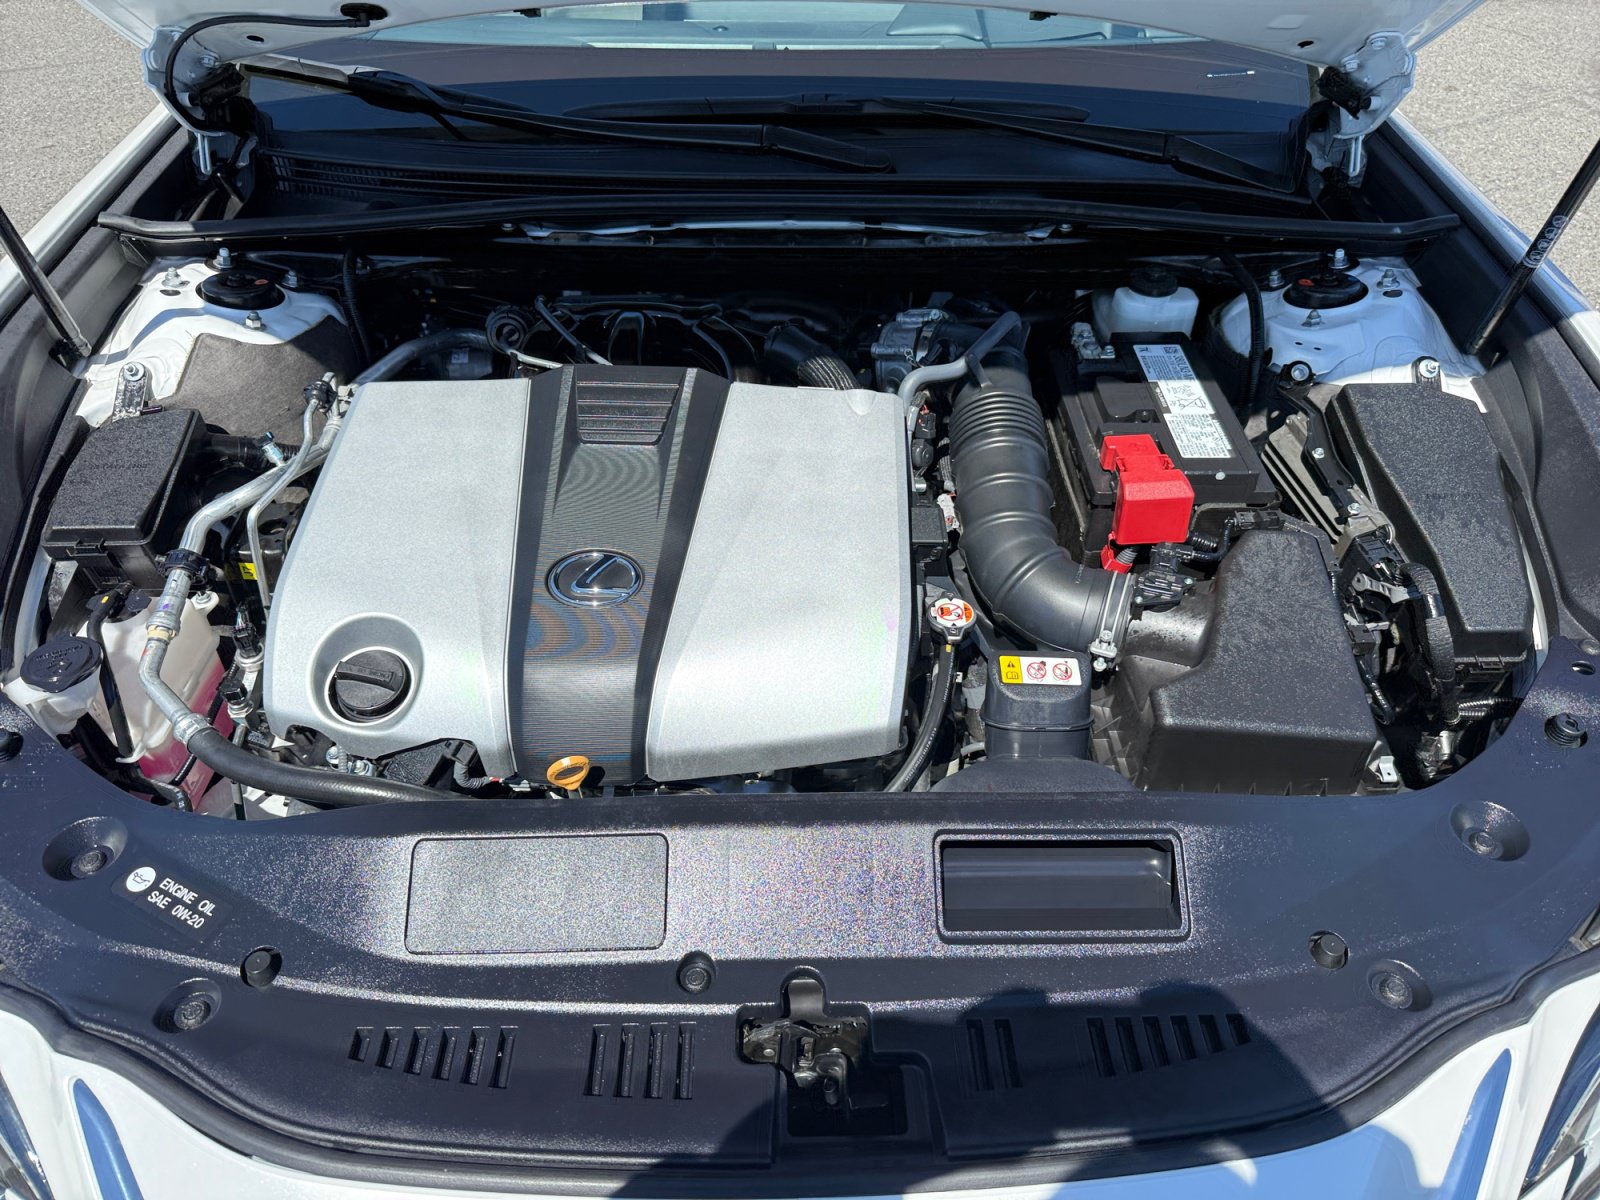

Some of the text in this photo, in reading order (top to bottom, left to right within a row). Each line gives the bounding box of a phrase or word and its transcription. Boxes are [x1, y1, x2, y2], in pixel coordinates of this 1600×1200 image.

[147, 890, 205, 929] SAE 0W-20
[159, 877, 216, 916] ENGINE OIL
